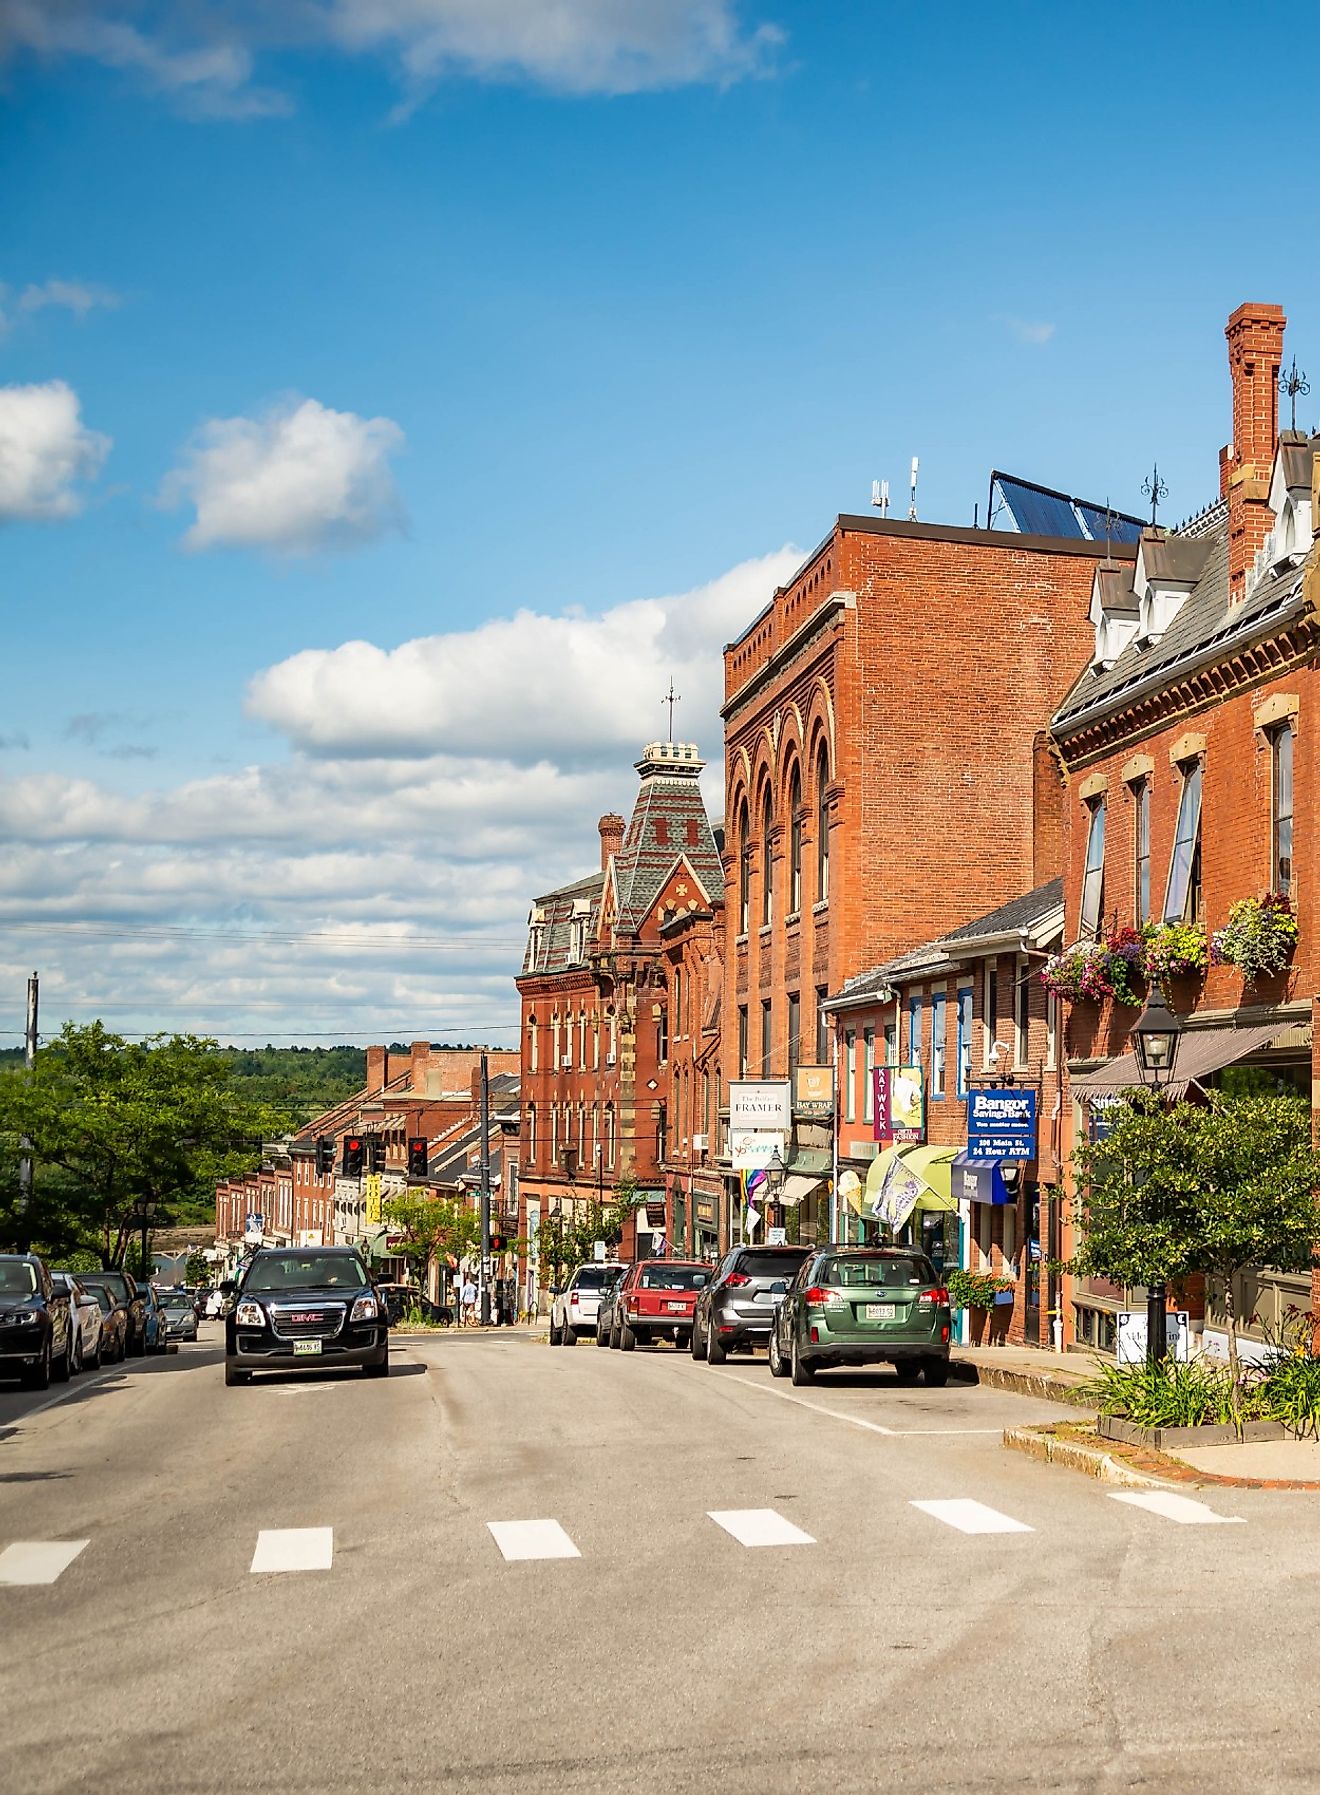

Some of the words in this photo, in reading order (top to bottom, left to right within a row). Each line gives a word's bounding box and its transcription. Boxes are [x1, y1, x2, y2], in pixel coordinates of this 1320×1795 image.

[877, 1068, 887, 1130] KATWALK
[735, 1103, 782, 1112] FRAMER
[797, 1101, 810, 1109] BAY
[812, 1101, 833, 1109] WRAP
[975, 1096, 1029, 1112] Bangor
[973, 1109, 1007, 1119] Savings
[291, 1313, 324, 1322] GMC
